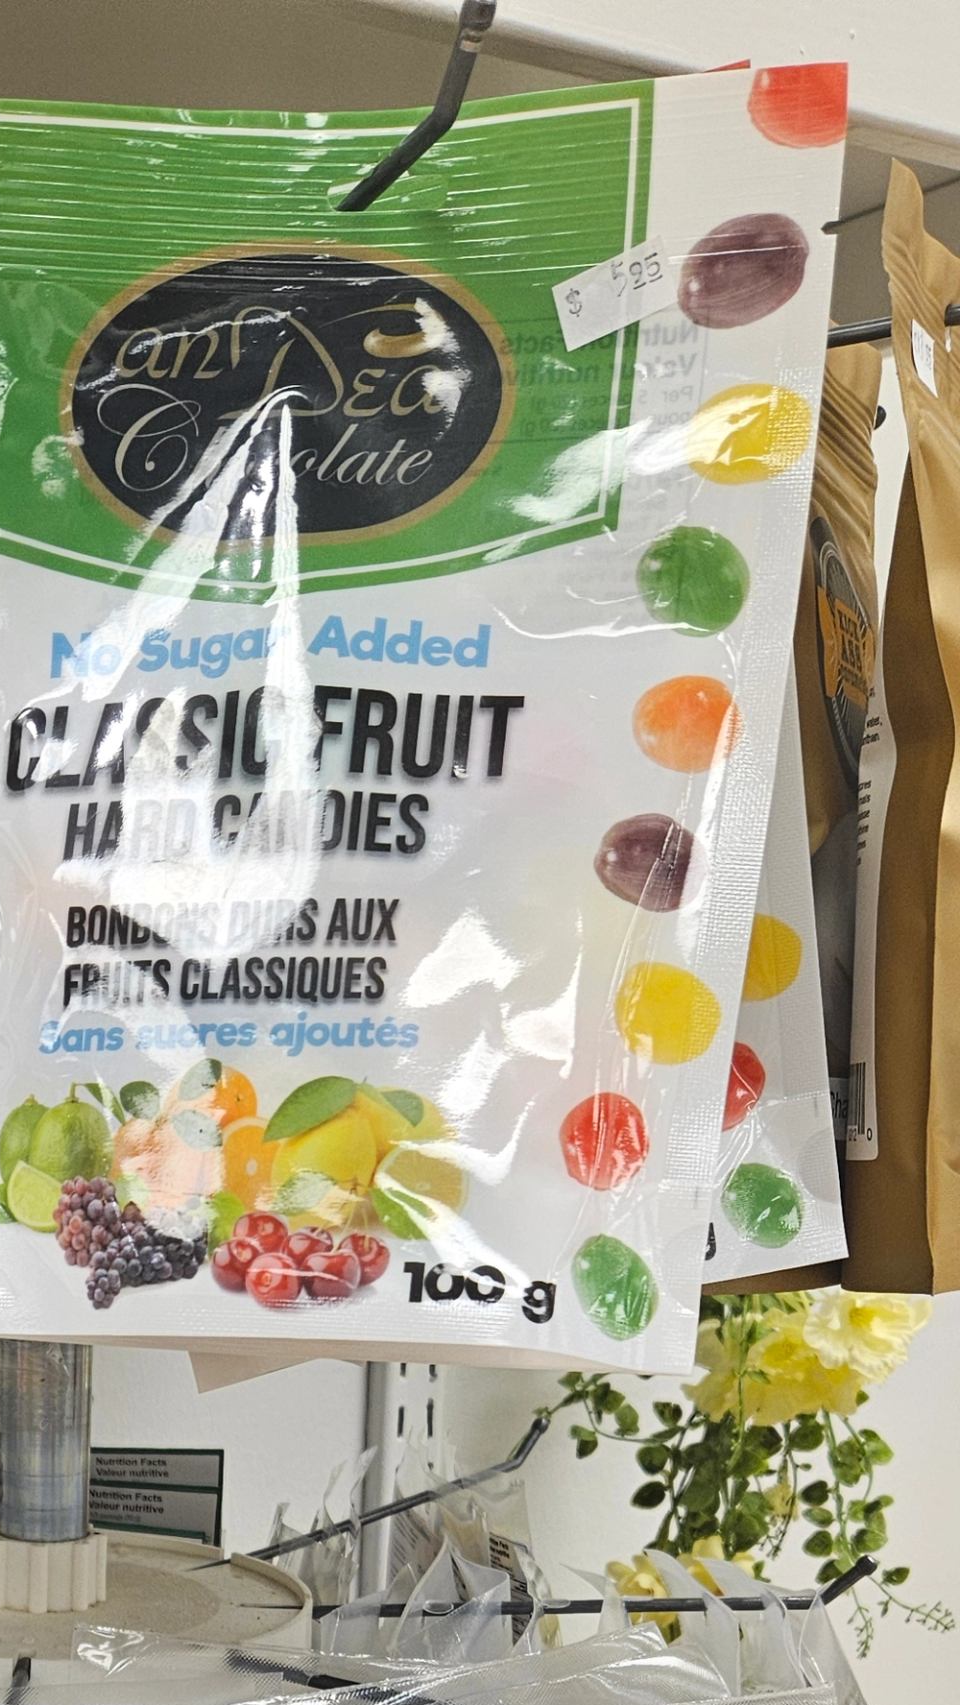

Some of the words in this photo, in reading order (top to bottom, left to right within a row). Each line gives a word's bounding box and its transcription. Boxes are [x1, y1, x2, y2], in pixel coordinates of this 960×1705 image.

[564, 287, 583, 318] $
[308, 614, 492, 669] Added
[312, 685, 525, 778] FRUIT
[326, 897, 400, 942] AUX
[179, 955, 387, 1003] CLASSIQUES
[38, 1019, 124, 1055] Sans
[136, 1019, 257, 1049] sucres
[270, 1011, 420, 1058] ajoutés
[403, 1260, 506, 1304] 100
[521, 1280, 558, 1324] g
[95, 1457, 137, 1467] Nutrition
[140, 1458, 167, 1467] Facts
[95, 1468, 126, 1478] Valeur
[129, 1469, 169, 1478] nutritive
[89, 1489, 132, 1501] Nutrition
[135, 1492, 163, 1503] Facts
[122, 1502, 165, 1515] nutritive
